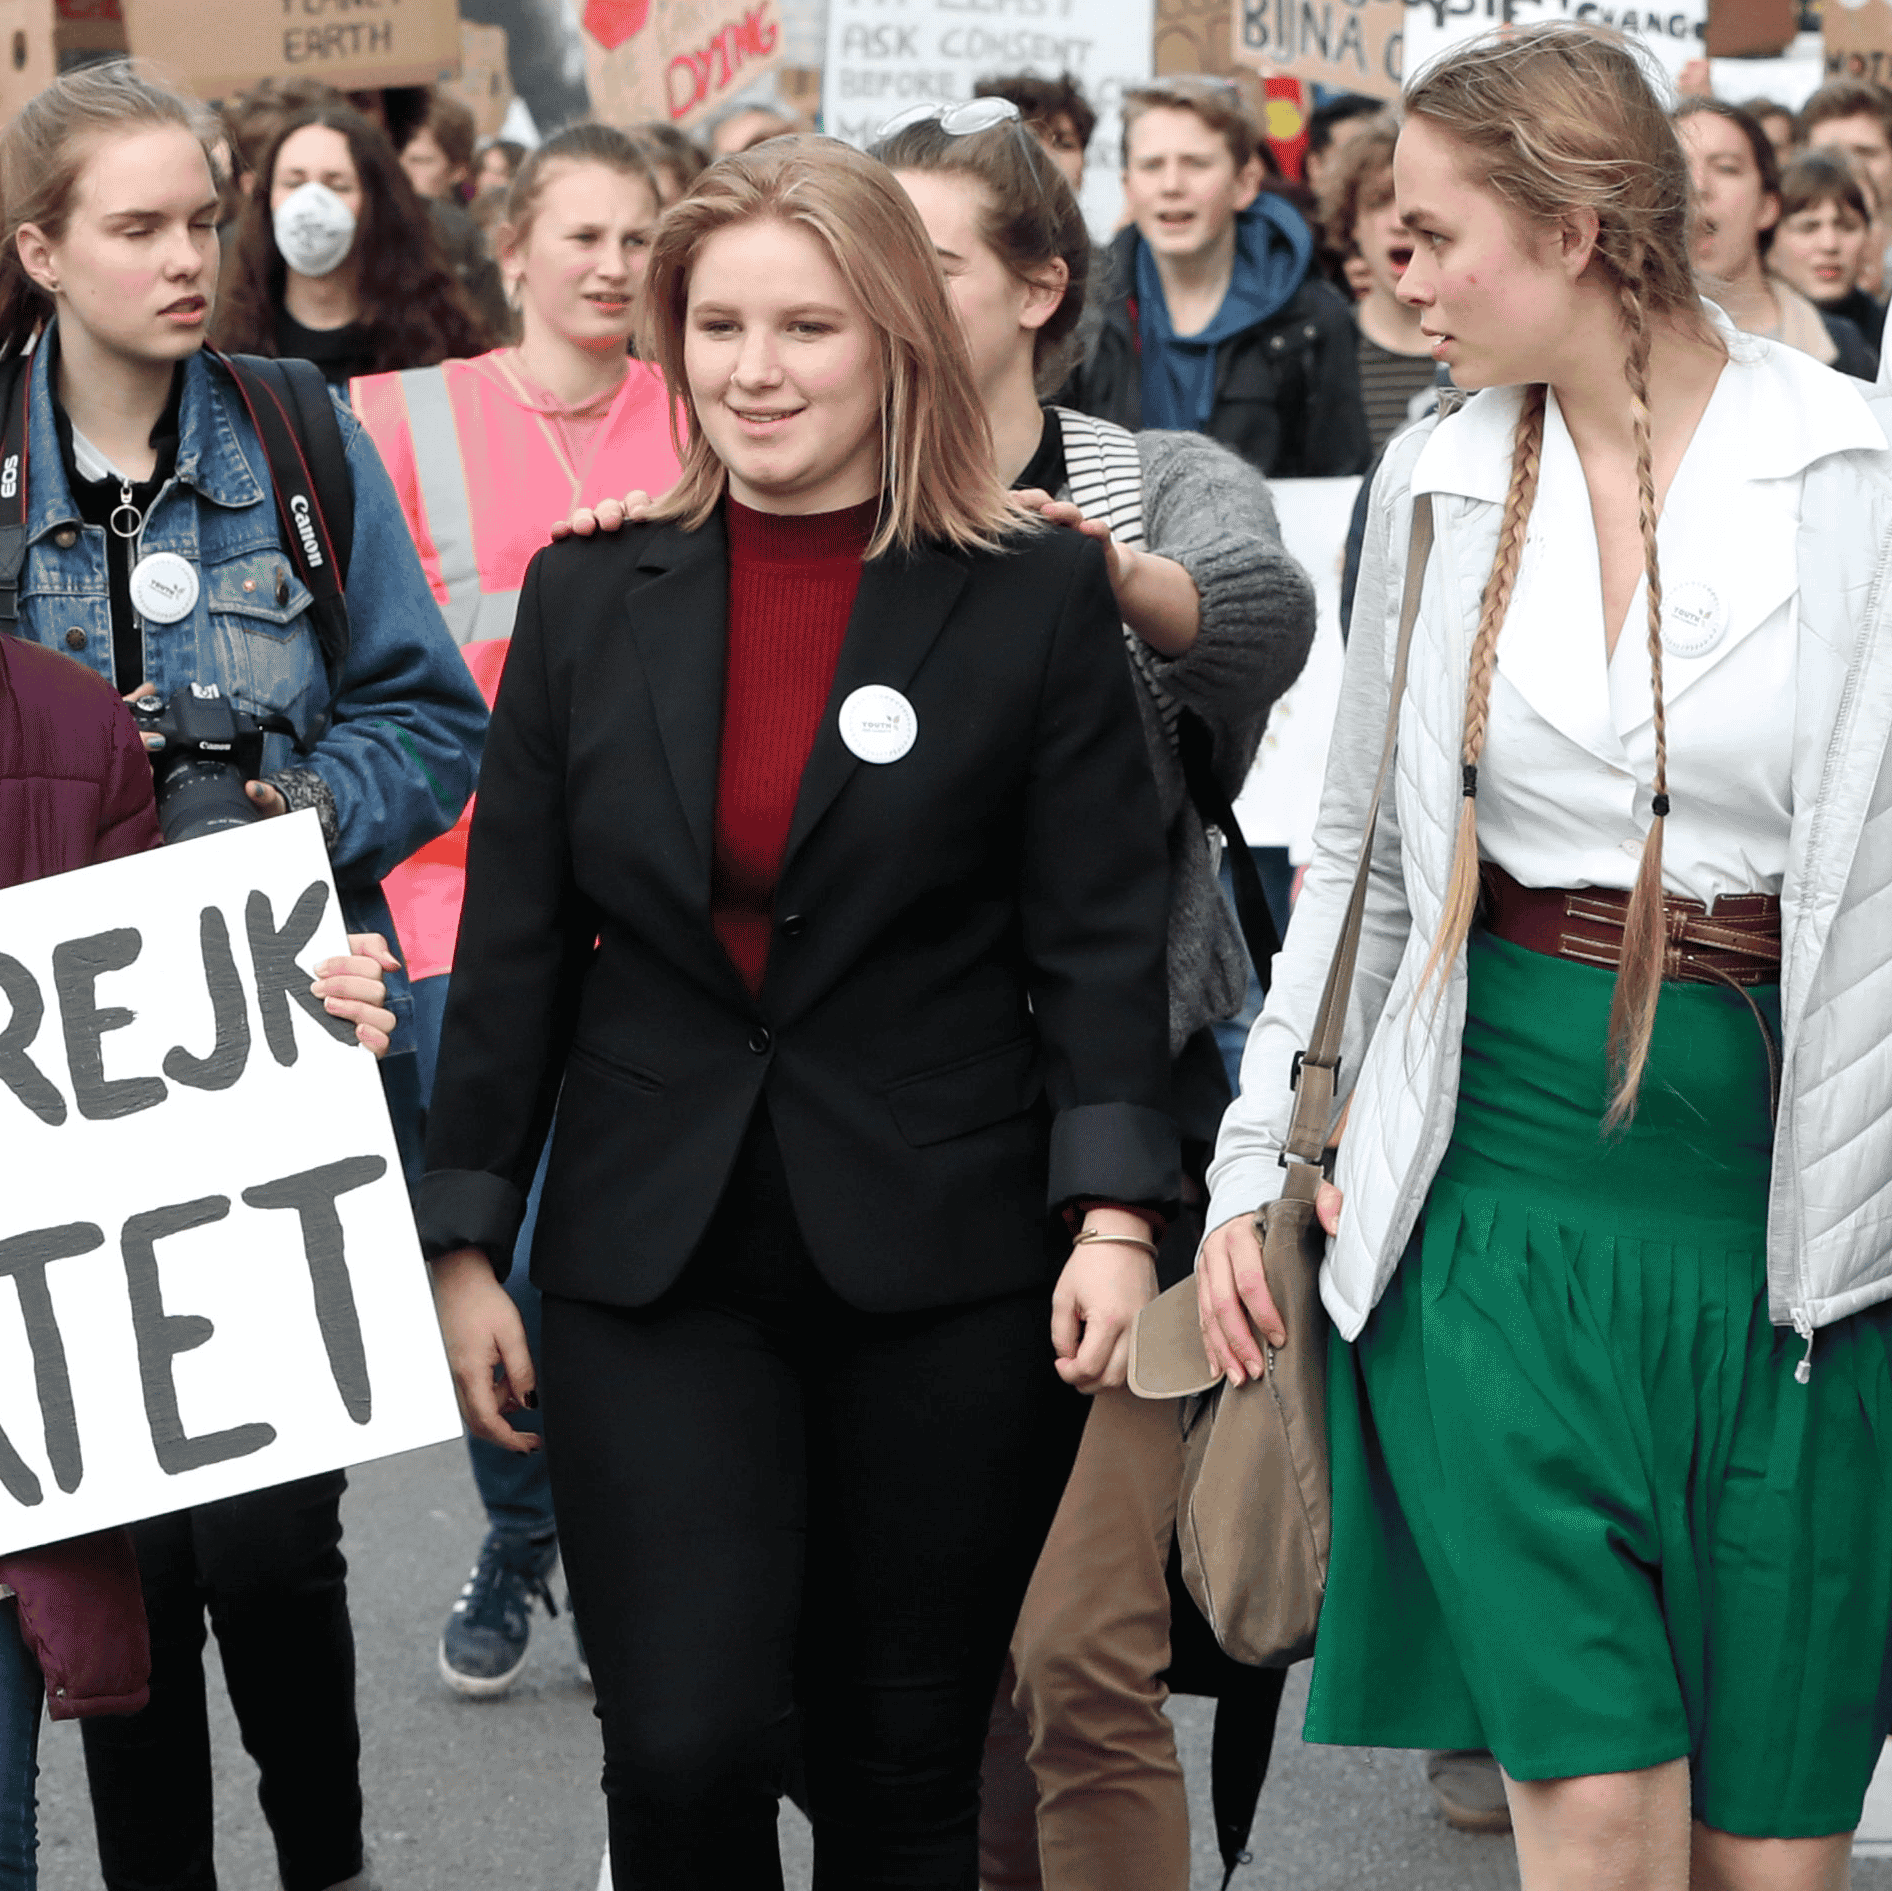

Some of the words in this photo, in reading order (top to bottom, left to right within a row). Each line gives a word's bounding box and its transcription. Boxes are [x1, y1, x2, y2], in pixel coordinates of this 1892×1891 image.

[282, 19, 394, 64] EARTH
[842, 23, 919, 59] ASK
[1, 454, 19, 498] EOS
[290, 494, 323, 568] Canon
[862, 721, 892, 729] YOUTH
